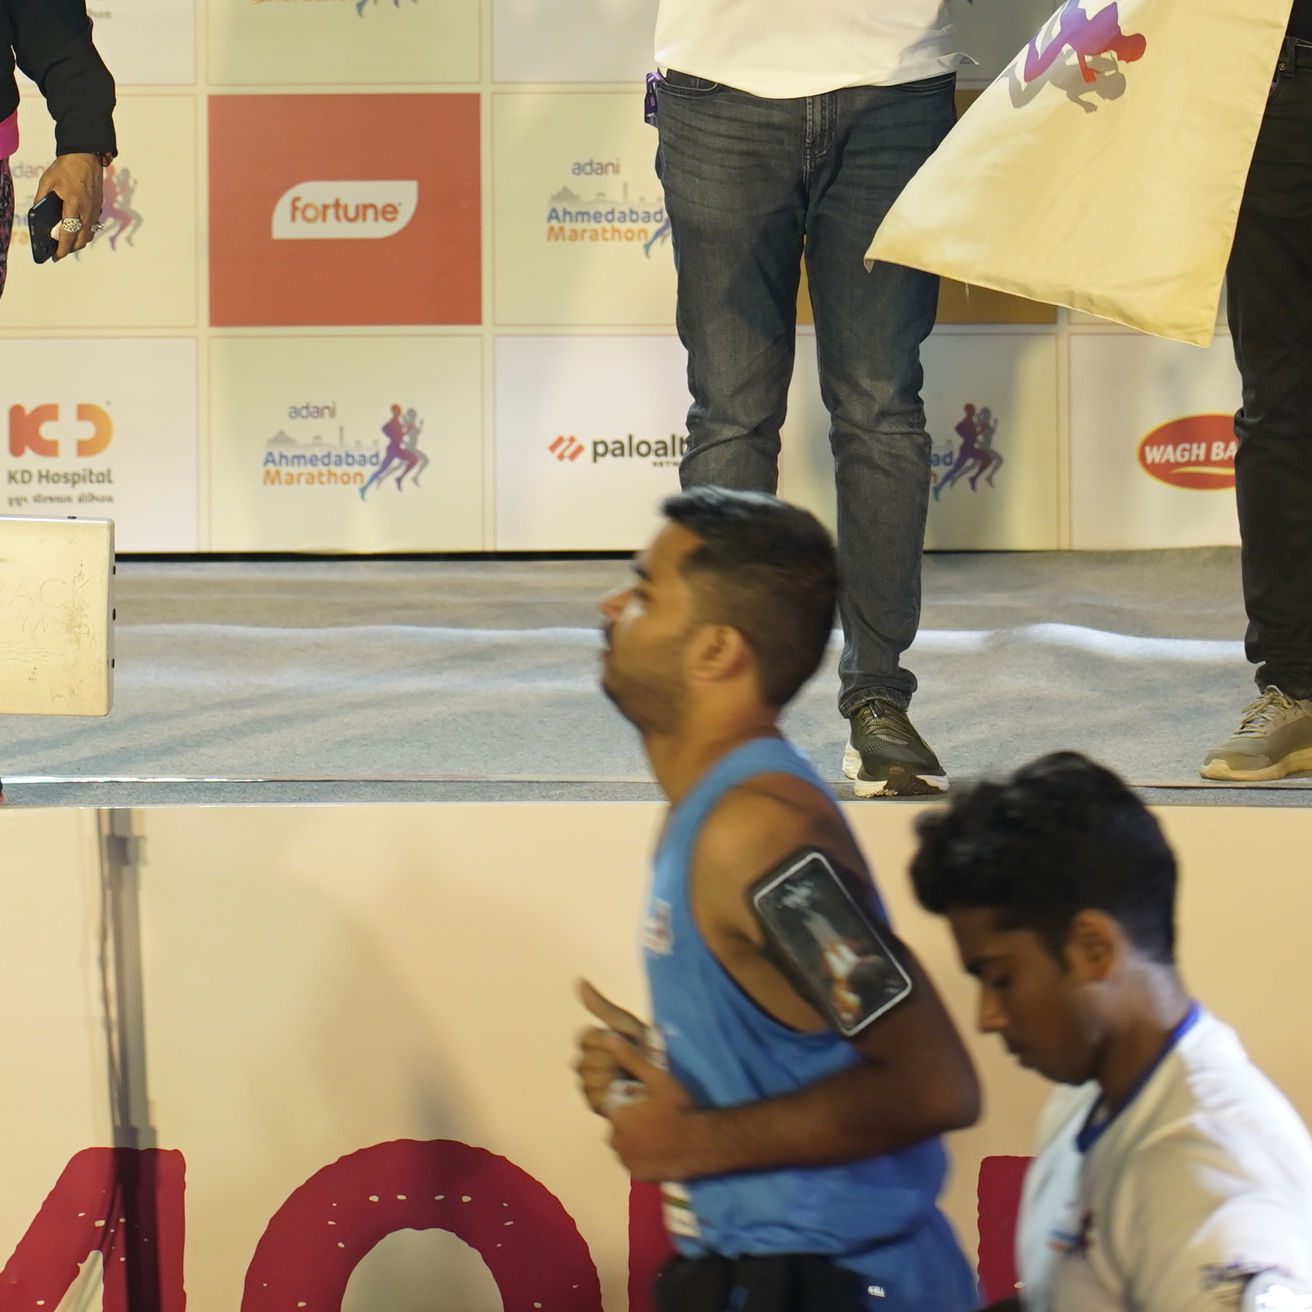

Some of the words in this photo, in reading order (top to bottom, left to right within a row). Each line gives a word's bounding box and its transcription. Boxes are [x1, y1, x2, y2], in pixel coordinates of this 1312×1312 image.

[572, 158, 620, 177] adani
[290, 196, 401, 224] fortune
[547, 208, 663, 225] Ahmedabad
[547, 225, 649, 243] Marathon
[288, 403, 336, 421] adani
[592, 434, 686, 464] paloalt
[1144, 442, 1207, 465] WAGH
[263, 452, 379, 469] Ahmedabad
[8, 471, 32, 484] KD
[38, 469, 113, 488] Hospital
[263, 469, 365, 487] Marathon
